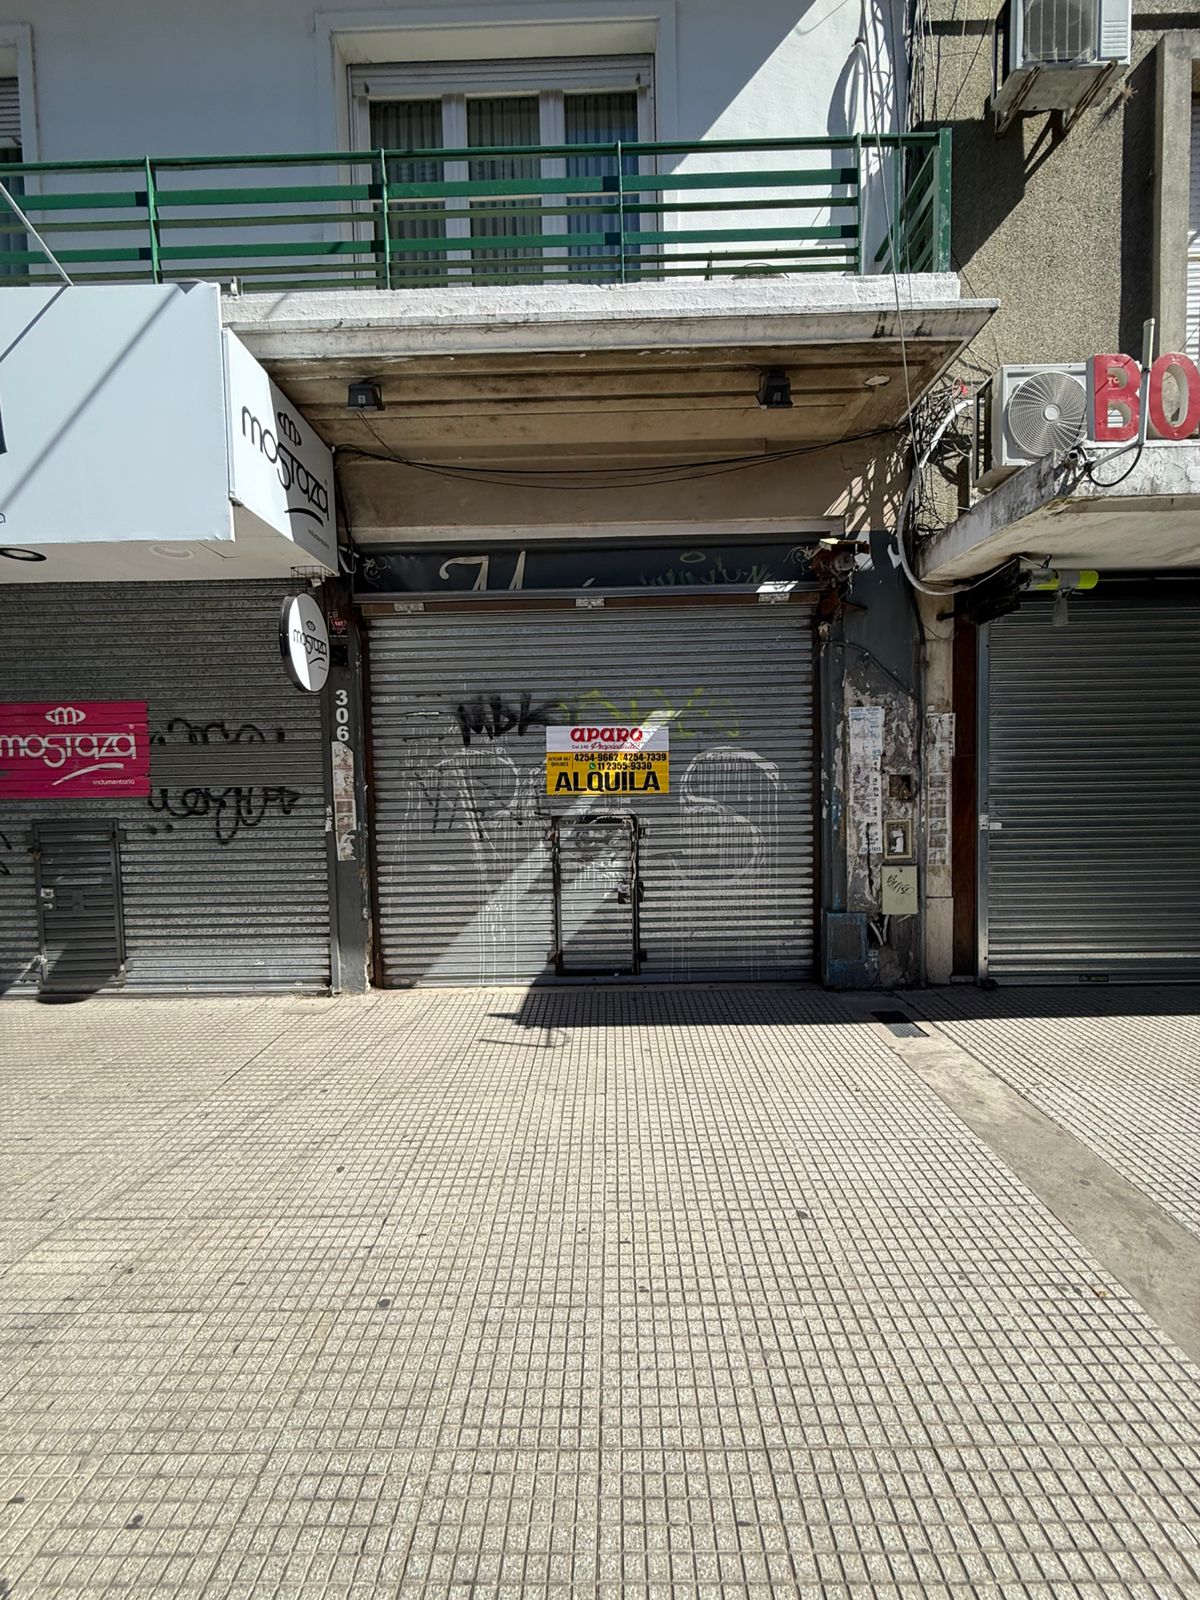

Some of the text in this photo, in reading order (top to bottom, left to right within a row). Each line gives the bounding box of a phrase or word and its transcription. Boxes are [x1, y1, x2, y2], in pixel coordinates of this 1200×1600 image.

[335, 689, 350, 742] 306
[574, 753, 667, 762] 4254-9662 4254-7339
[597, 762, 652, 770] 11 2355-9330
[555, 771, 660, 792] ALQUILA
